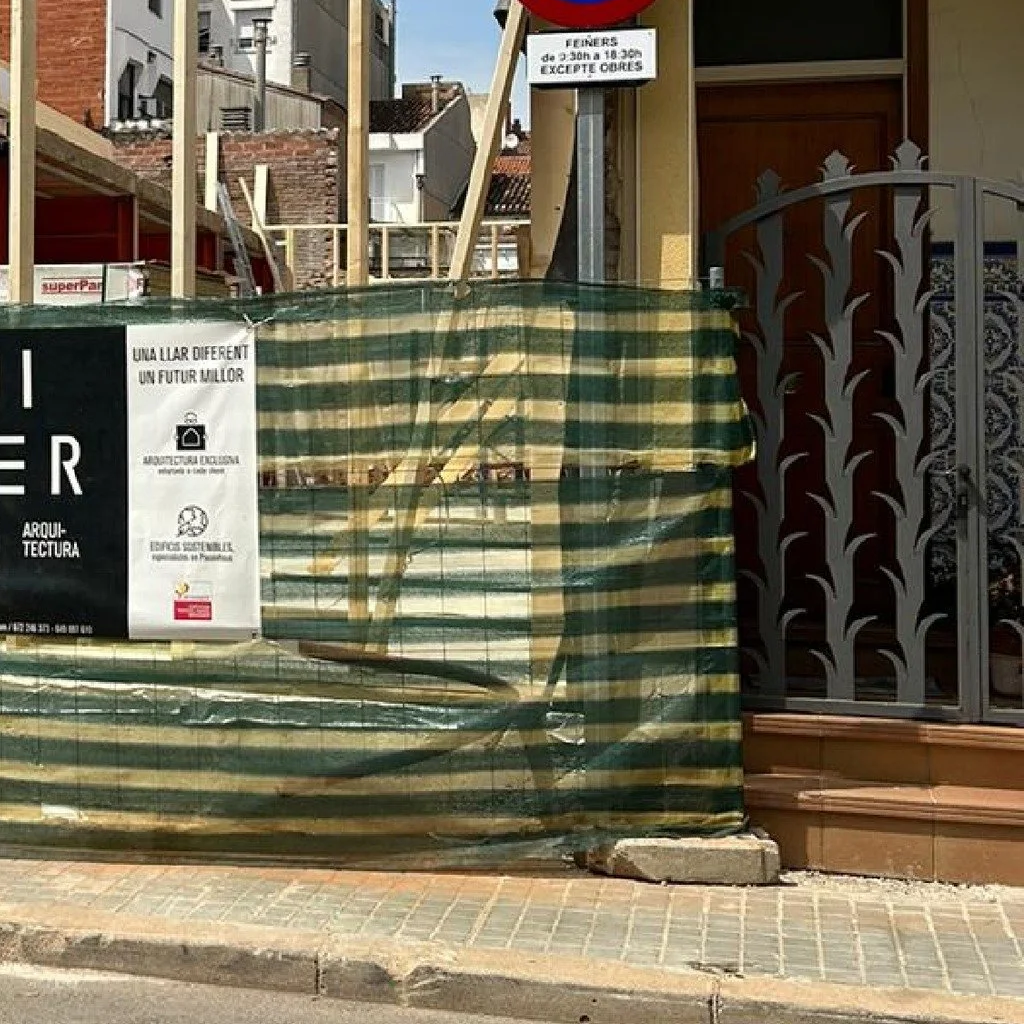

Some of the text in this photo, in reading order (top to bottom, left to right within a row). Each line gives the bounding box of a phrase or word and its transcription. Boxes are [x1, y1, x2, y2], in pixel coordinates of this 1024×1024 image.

[541, 53, 555, 63] de
[593, 51, 600, 61] a
[540, 60, 643, 75] EXCEPTE OBRES
[133, 344, 249, 362] UNA LLAR DIFERENT
[139, 367, 245, 385] UN FUTUR MILLOR
[22, 521, 67, 539] ARQUI-
[22, 541, 80, 558] TECTURA
